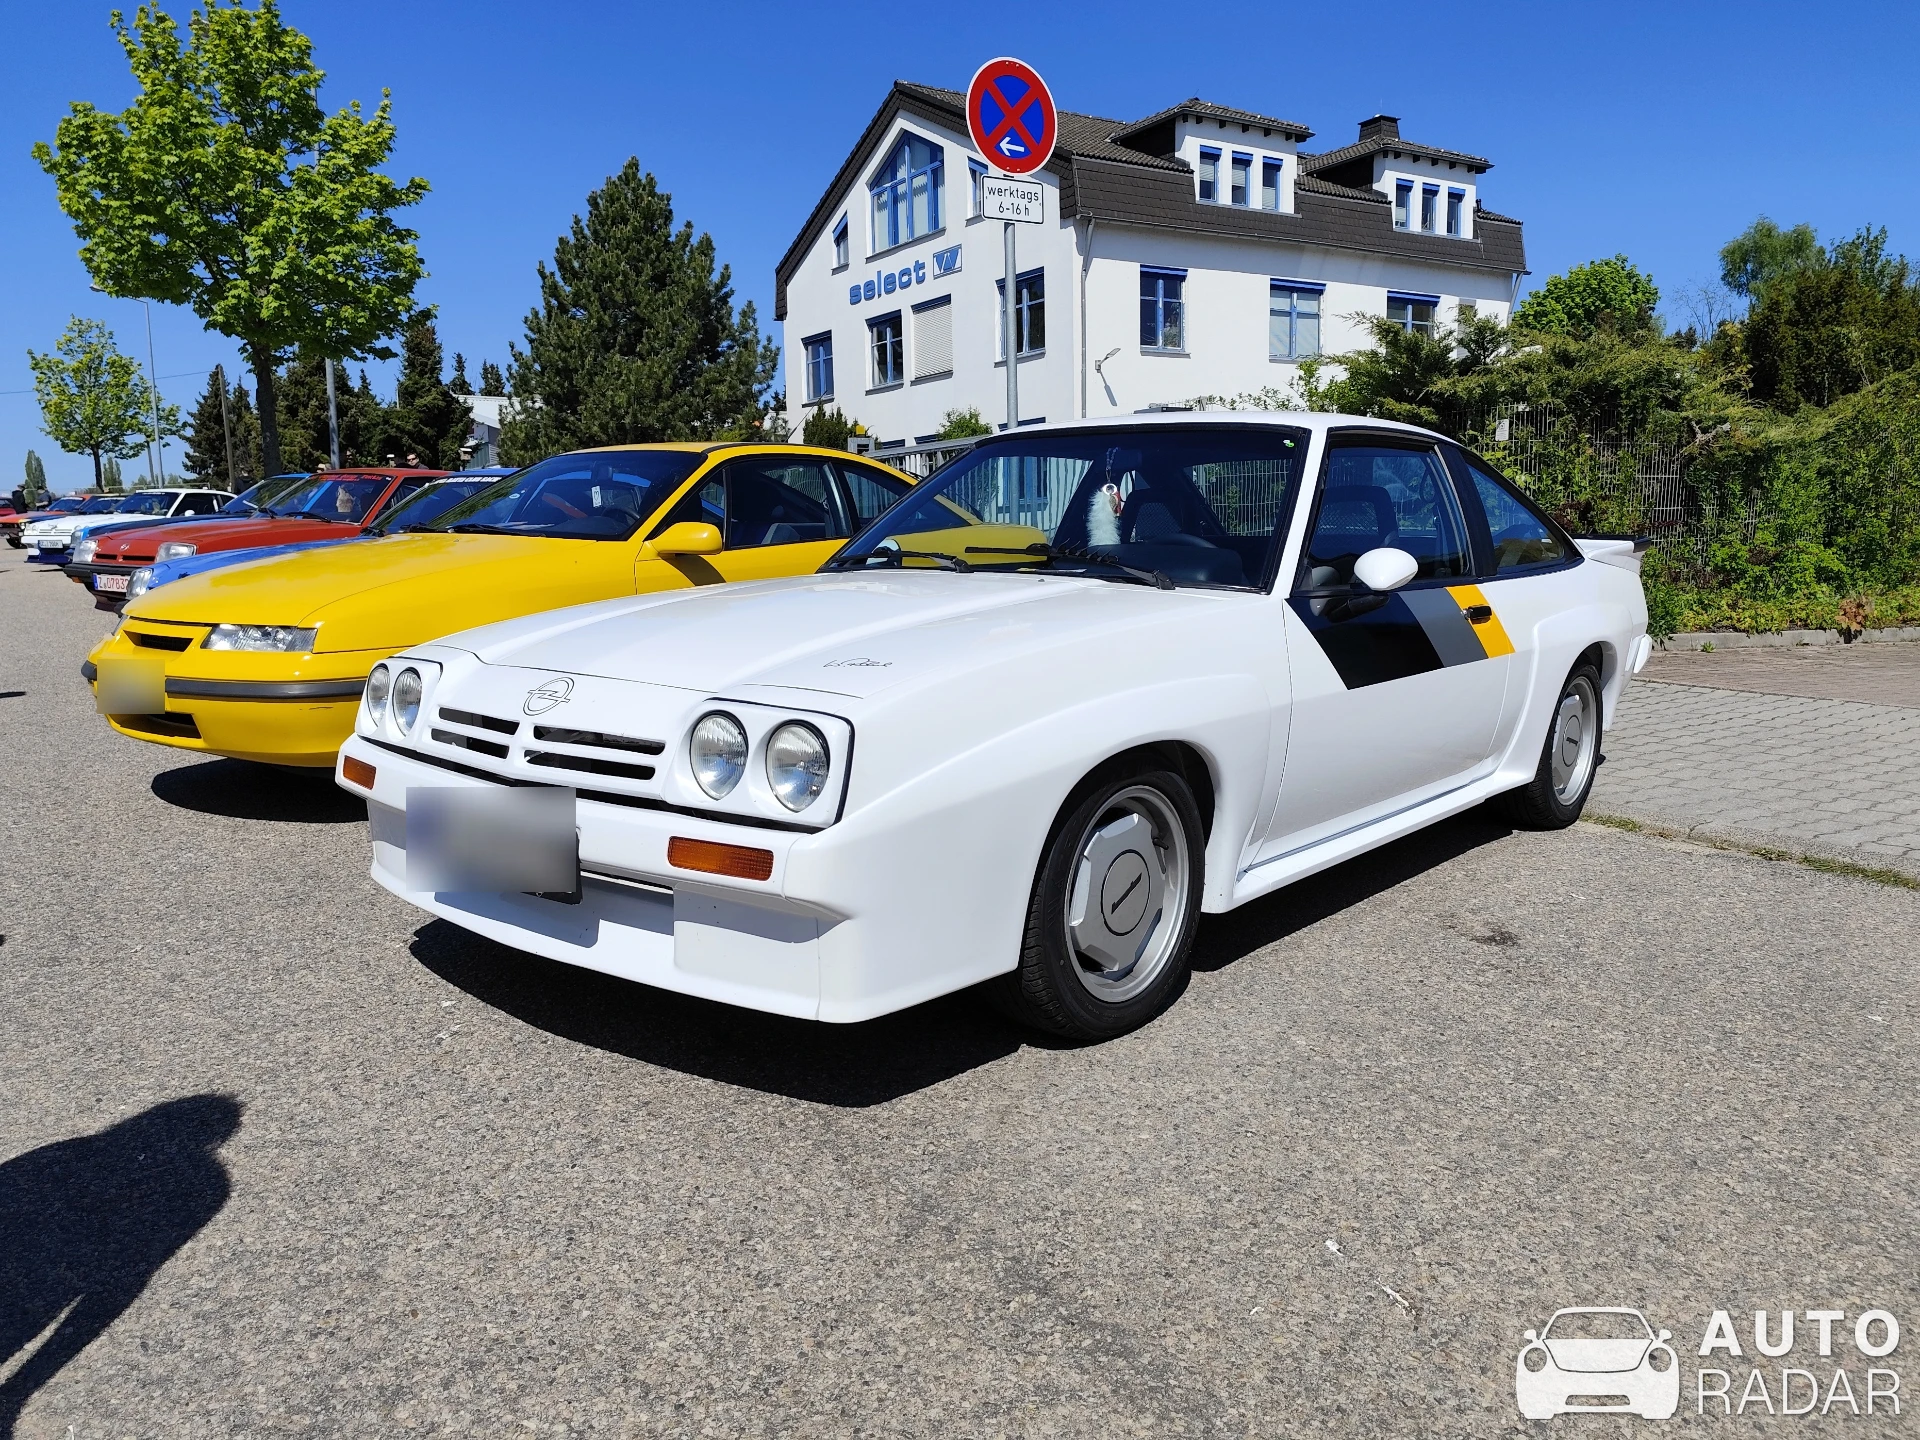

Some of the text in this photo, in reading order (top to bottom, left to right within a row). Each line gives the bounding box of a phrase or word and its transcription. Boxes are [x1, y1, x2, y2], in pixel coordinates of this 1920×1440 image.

[987, 186, 1039, 203] werktags
[998, 201, 1030, 216] 6-16 h
[849, 259, 926, 305] select
